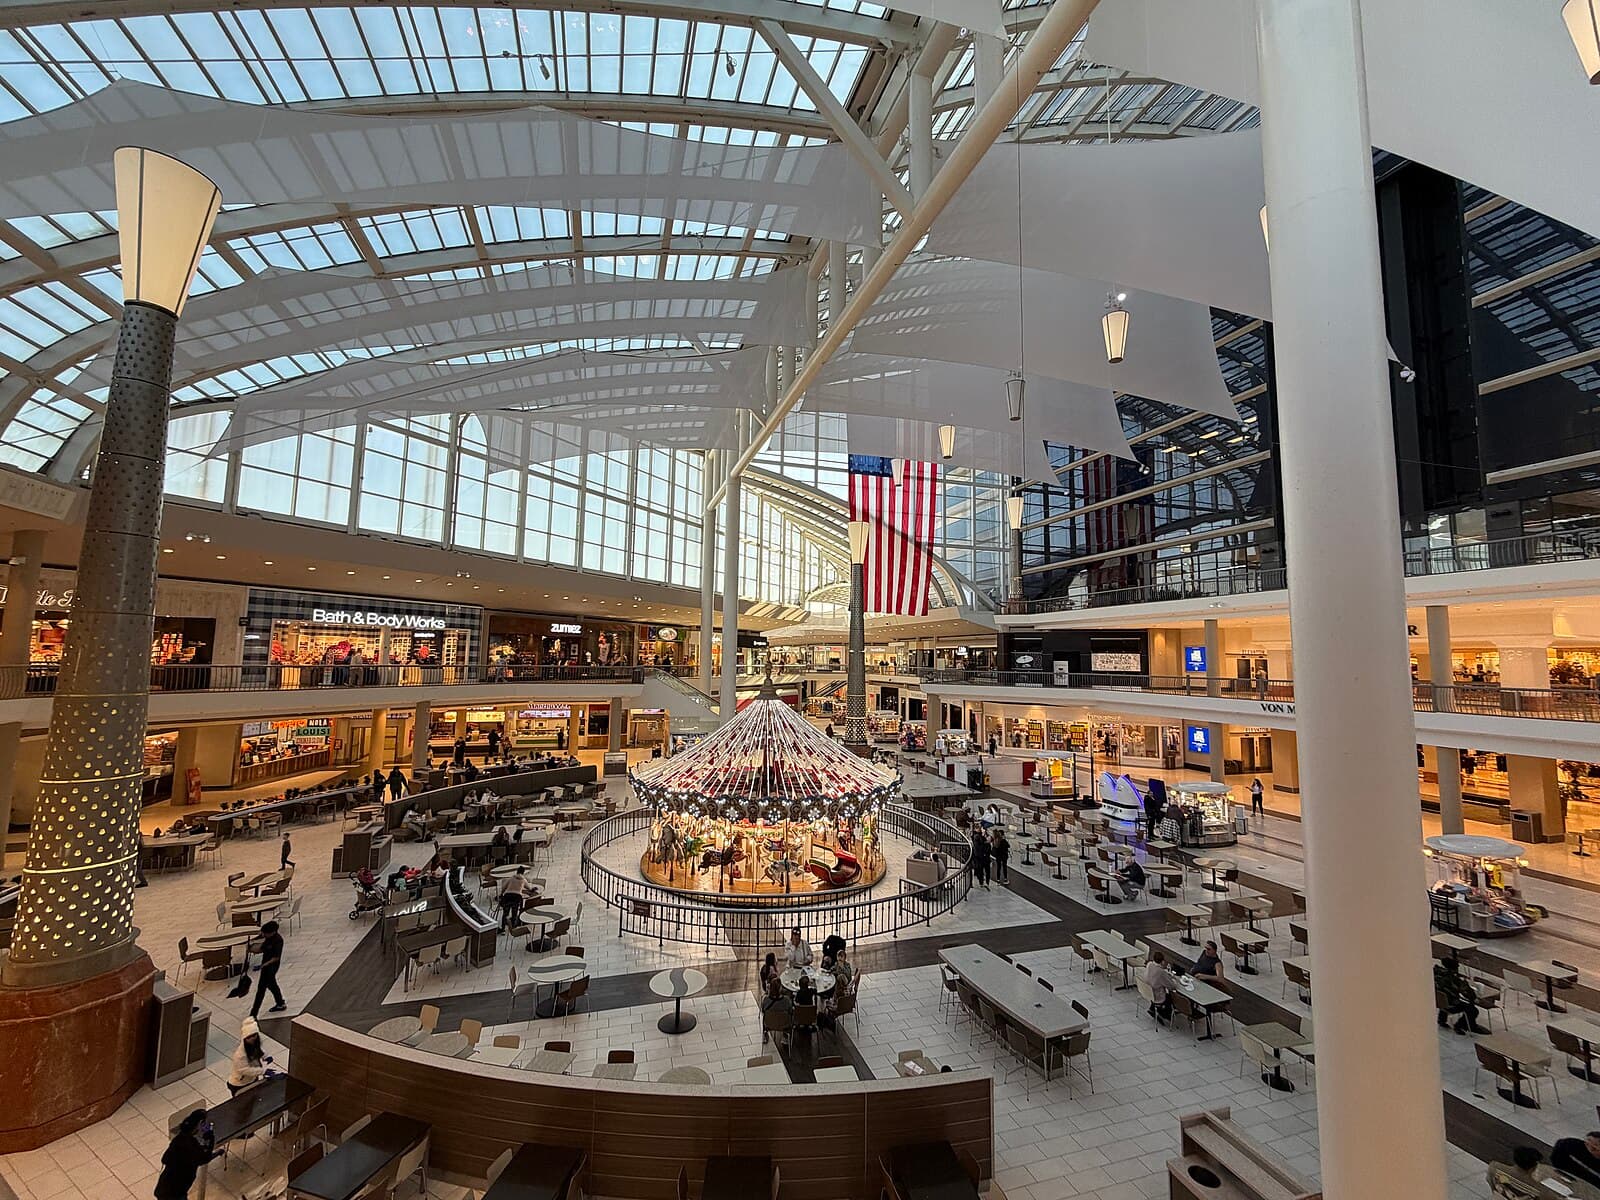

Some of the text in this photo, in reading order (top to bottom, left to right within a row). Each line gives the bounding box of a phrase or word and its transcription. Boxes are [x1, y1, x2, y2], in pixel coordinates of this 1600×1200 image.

[312, 608, 446, 629] Bath & Body Works
[1260, 703, 1284, 713] VON
[308, 719, 328, 727] NOLA
